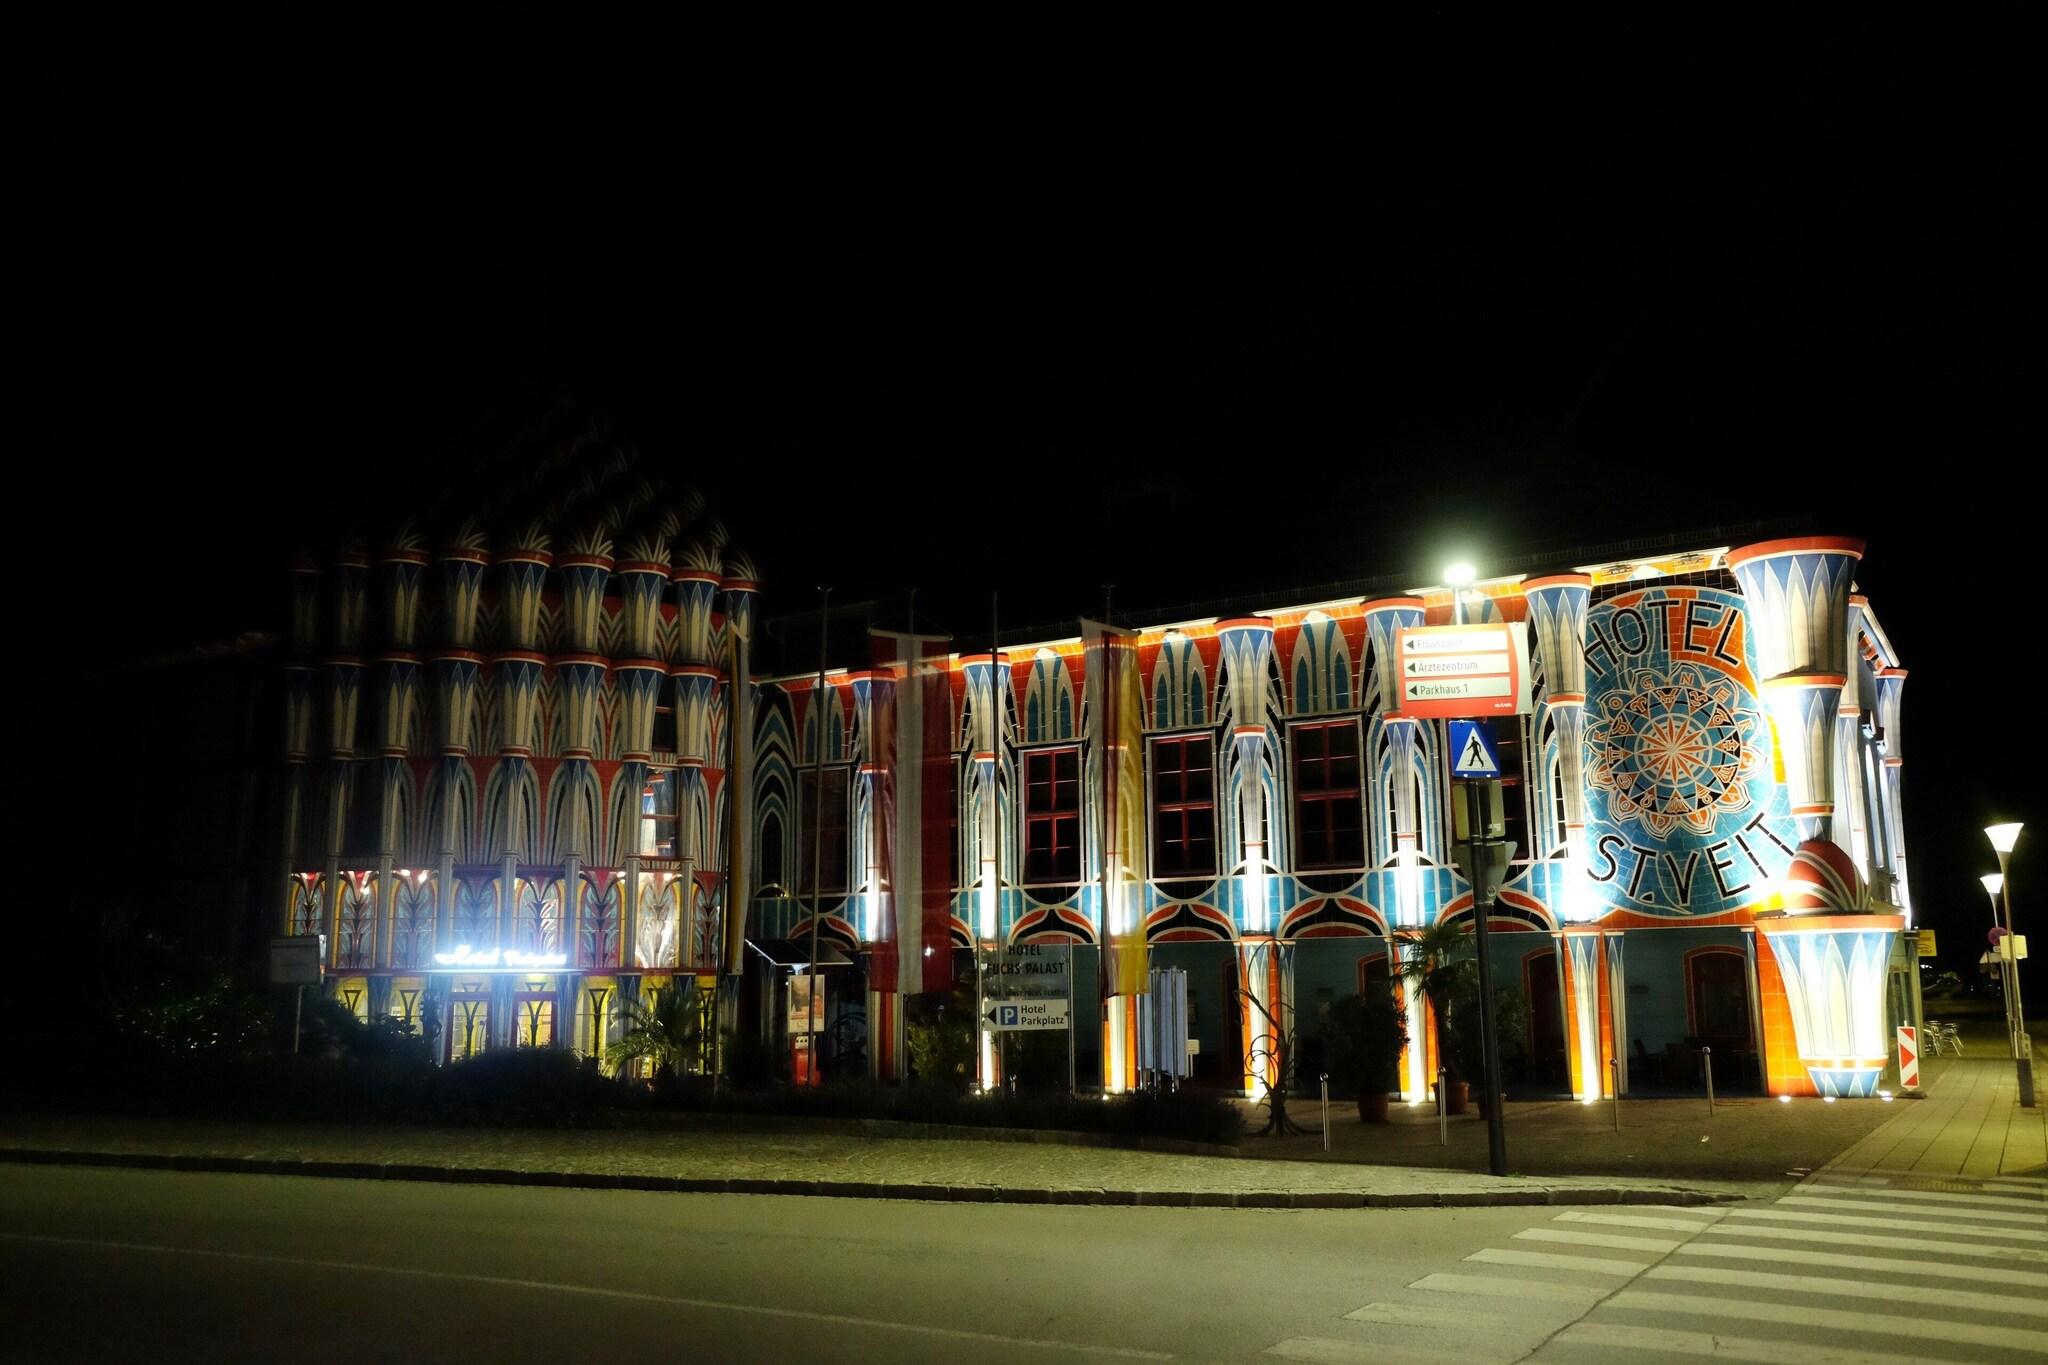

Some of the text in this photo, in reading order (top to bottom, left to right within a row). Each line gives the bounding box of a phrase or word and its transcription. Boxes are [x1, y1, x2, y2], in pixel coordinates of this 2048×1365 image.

[1577, 600, 1739, 676] HOTEL
[1420, 684, 1461, 695] Parkhaus
[1587, 812, 1794, 904] ST. VEIT
[1008, 944, 1041, 956] HOTEL
[986, 962, 1064, 975] FUCHS PALAST
[1021, 1004, 1046, 1014] Hotel
[1021, 1016, 1064, 1026] Parkplatz
